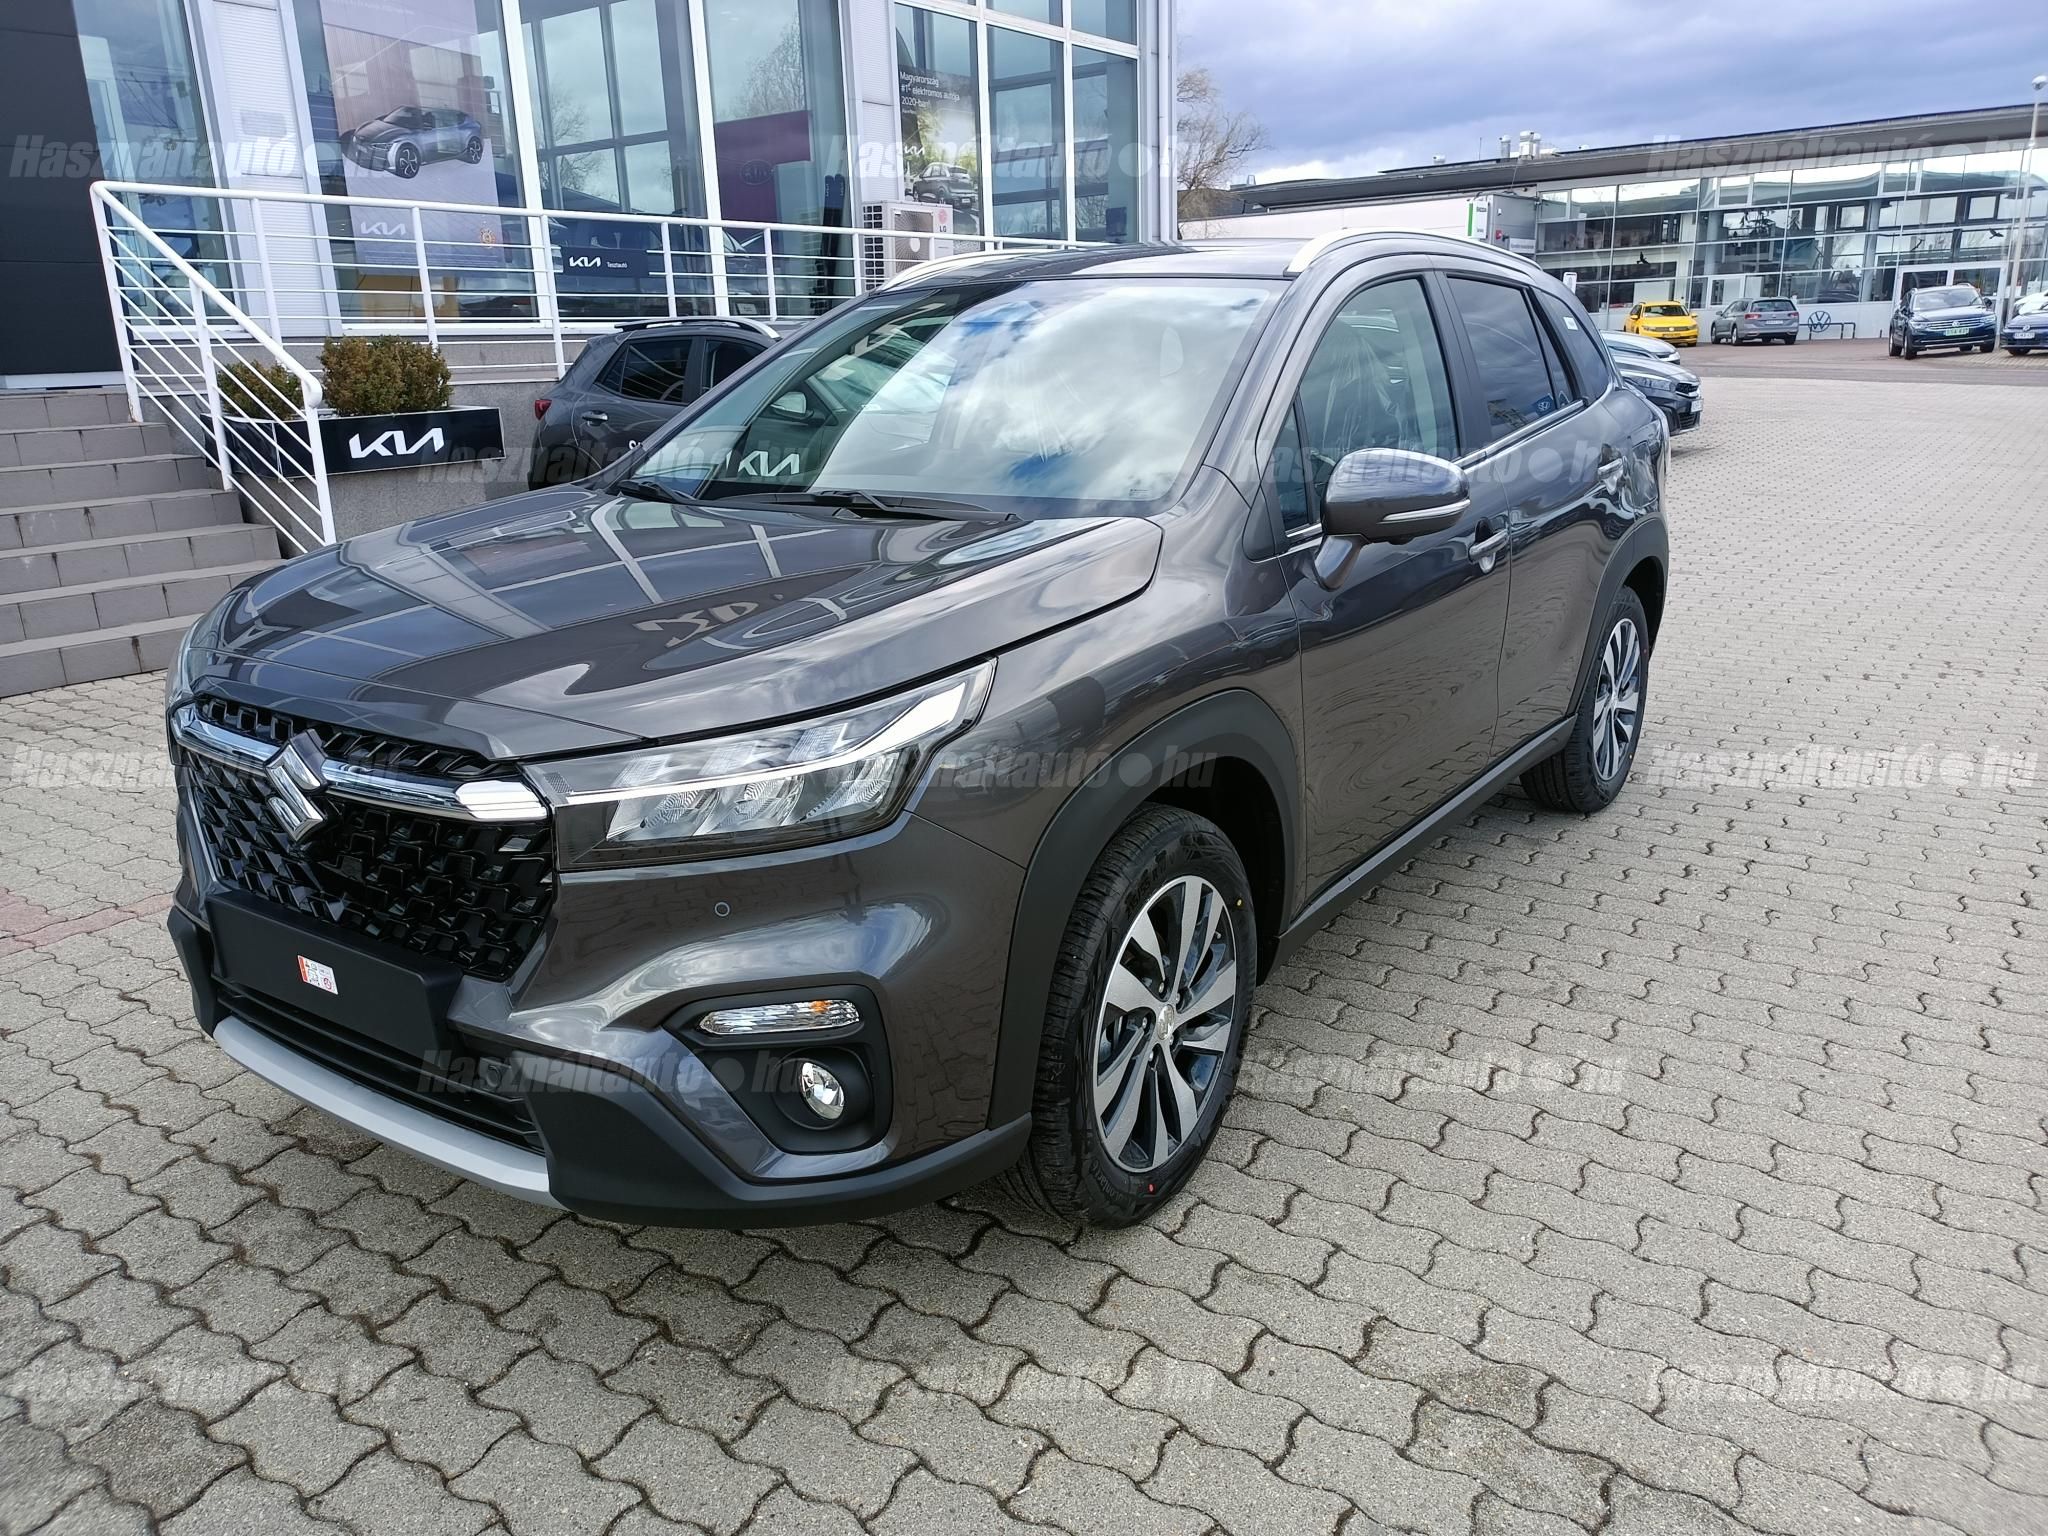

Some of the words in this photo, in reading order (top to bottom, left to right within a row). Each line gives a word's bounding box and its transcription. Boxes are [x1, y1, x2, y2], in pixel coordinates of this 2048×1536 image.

[360, 221, 407, 236] KIA
[569, 256, 601, 267] KIA
[348, 427, 445, 459] KIA
